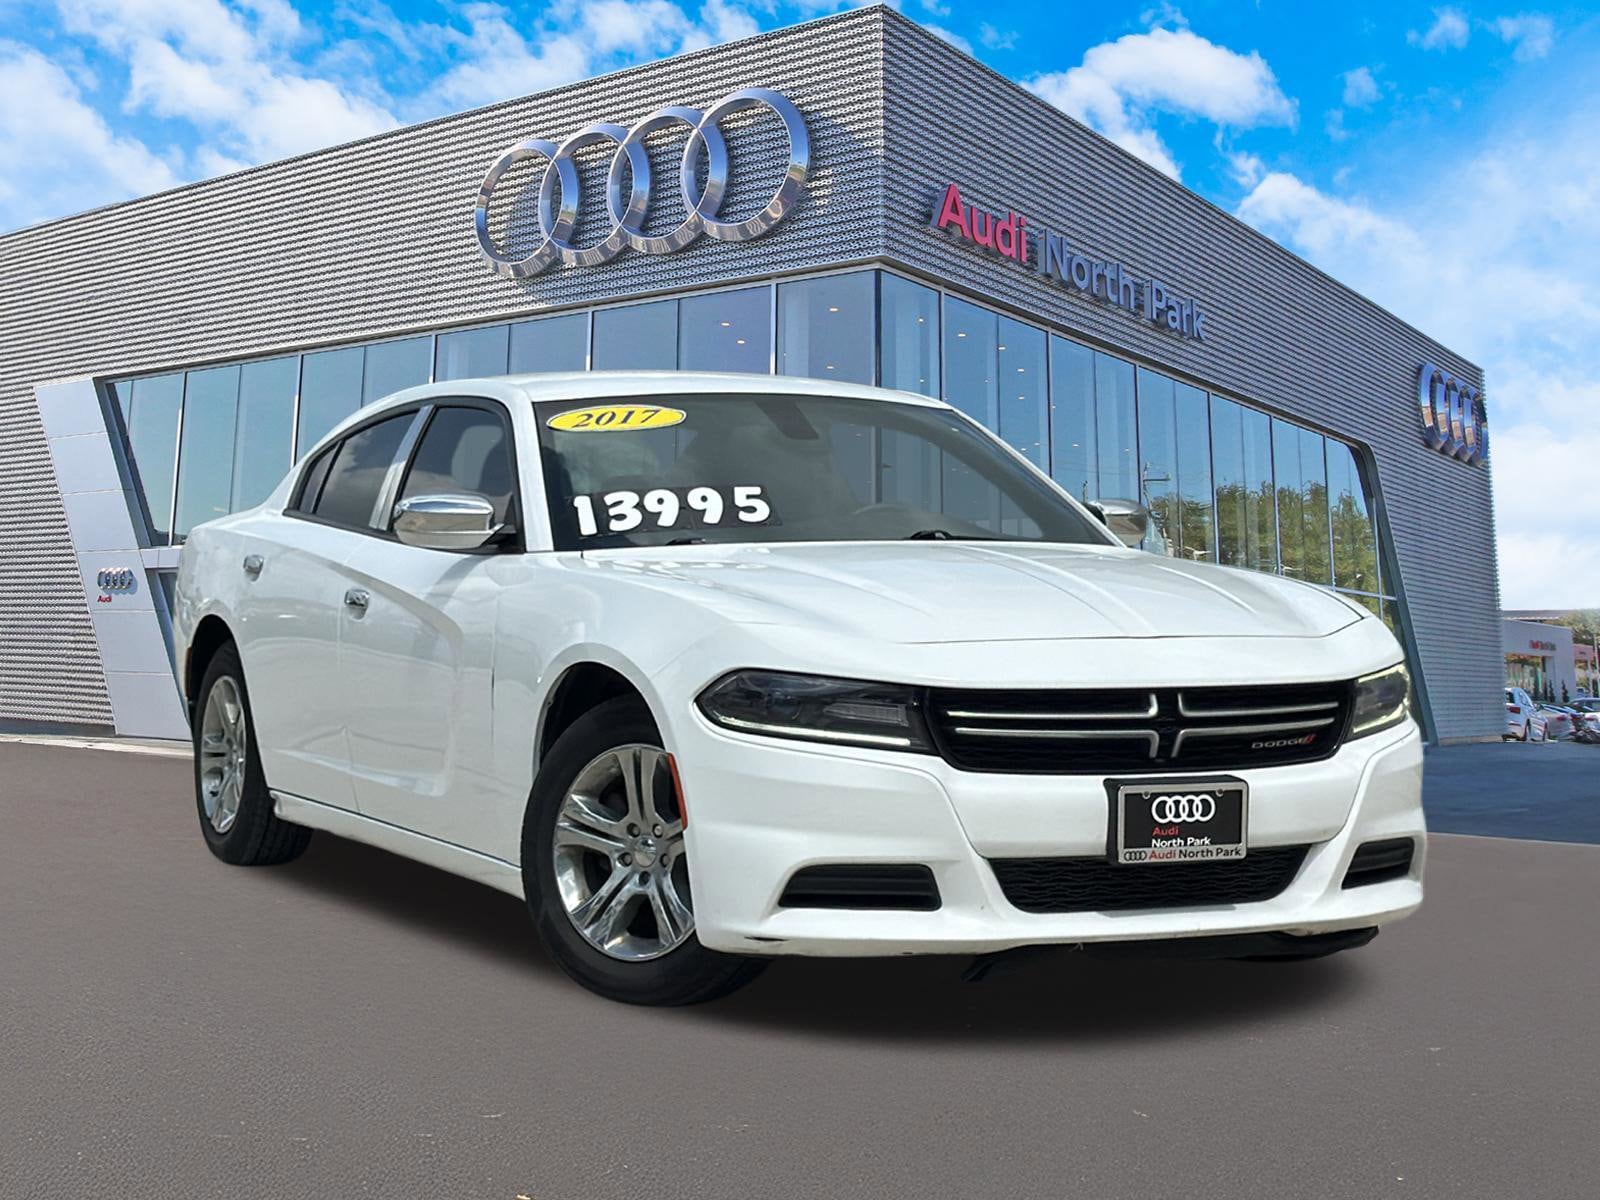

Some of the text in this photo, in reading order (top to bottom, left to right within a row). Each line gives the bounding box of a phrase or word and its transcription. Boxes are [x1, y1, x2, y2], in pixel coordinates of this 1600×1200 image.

[930, 183, 1206, 340] Audi North Park
[572, 409, 661, 428] 2017
[573, 486, 770, 536] 13995
[1152, 826, 1179, 836] Audi
[1152, 836, 1211, 848] North Park
[1149, 847, 1241, 860] Audi North Park
